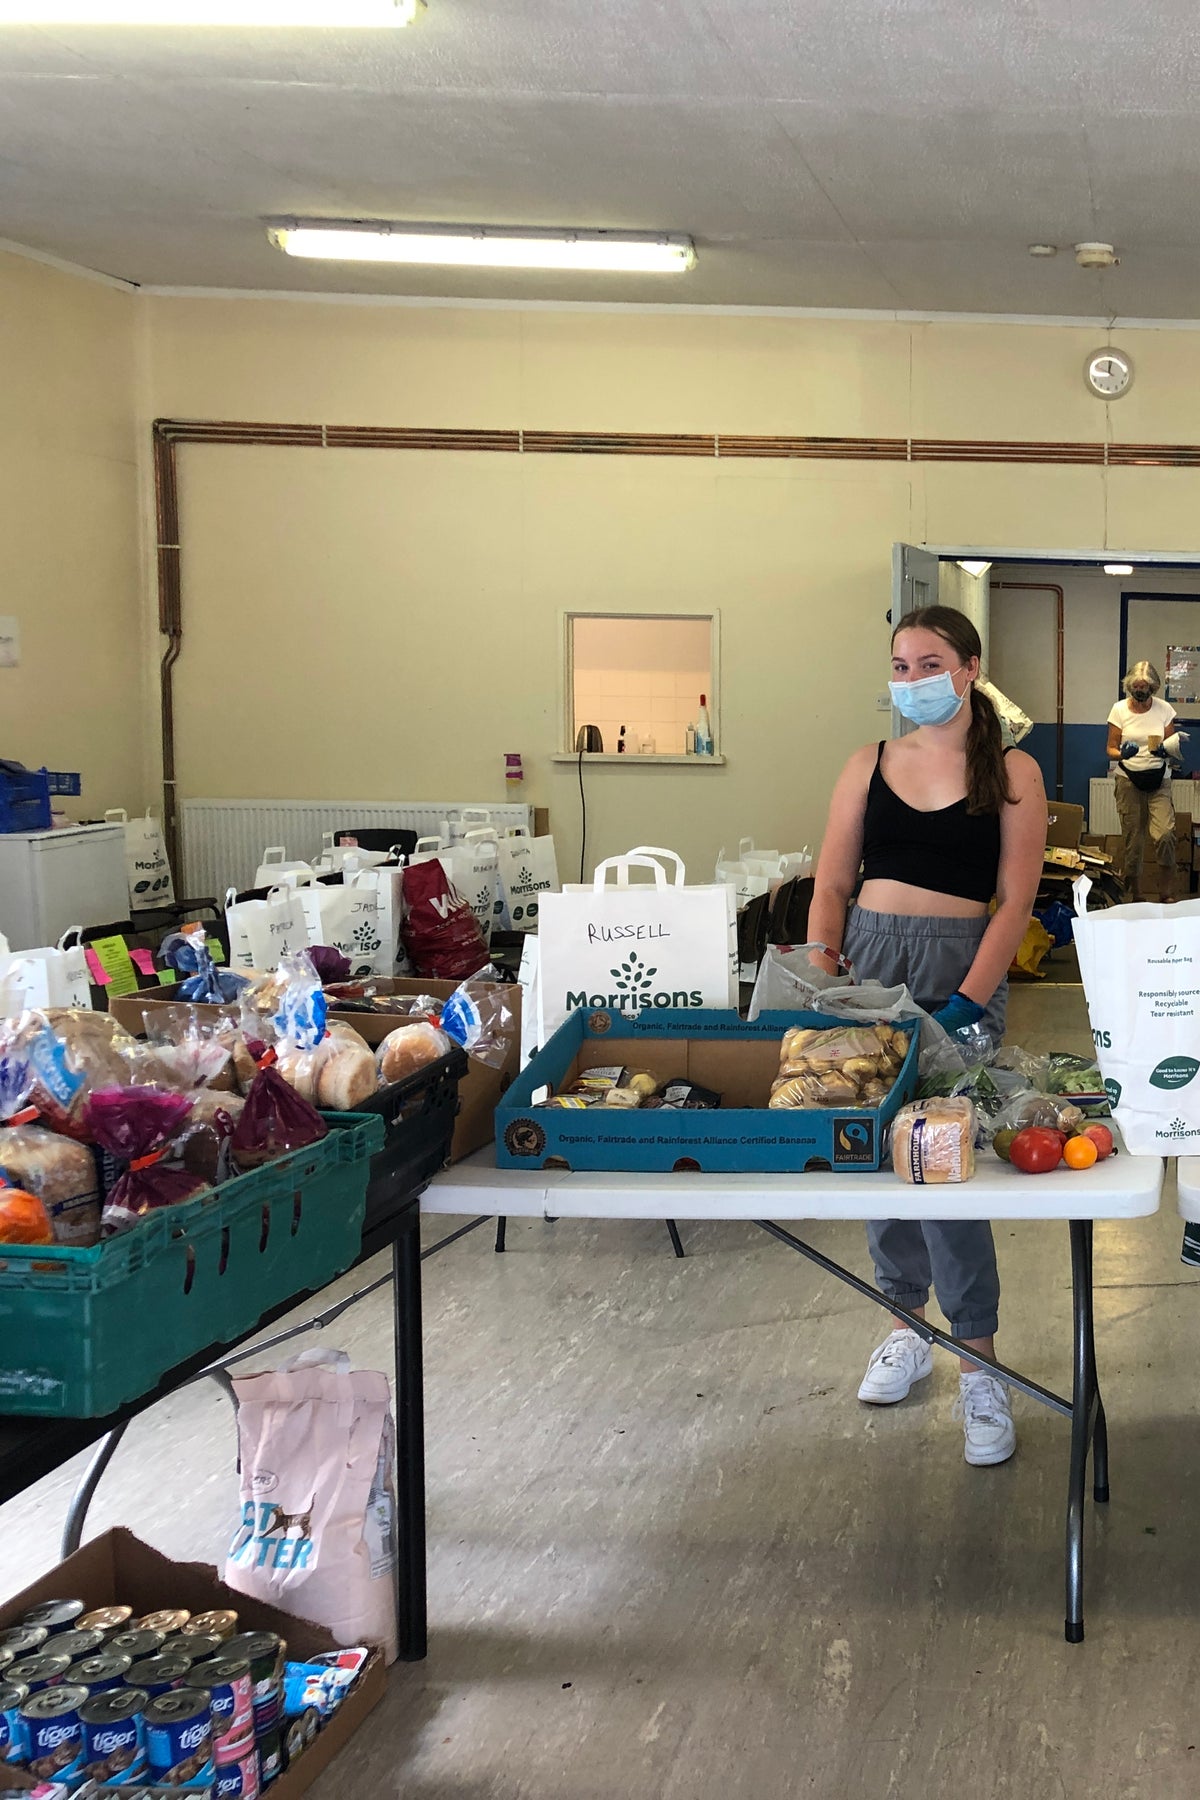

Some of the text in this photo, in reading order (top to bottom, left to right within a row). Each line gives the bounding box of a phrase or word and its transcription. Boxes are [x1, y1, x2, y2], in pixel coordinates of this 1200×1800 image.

[510, 880, 551, 895] Morrisons
[588, 923, 671, 944] RUSSELL
[566, 990, 704, 1011] Morrisons
[1138, 990, 1177, 999] Responsibly
[1155, 999, 1188, 1008] Recyclable
[1150, 1009, 1194, 1018] Tear resistant
[632, 1022, 666, 1032] Organic,
[667, 1022, 702, 1031] Fairtrade
[704, 1023, 718, 1031] and
[720, 1023, 760, 1032] Rainforest
[558, 1134, 596, 1144] Organic,
[598, 1134, 636, 1144] Fairtrade
[638, 1135, 655, 1144] and
[657, 1136, 702, 1144] Rainforest
[703, 1136, 738, 1144] Alliance
[741, 1136, 776, 1144] Certified
[913, 1128, 922, 1182] FARMHOUSE
[36, 1723, 80, 1748] tiger
[92, 1730, 135, 1754] tiger
